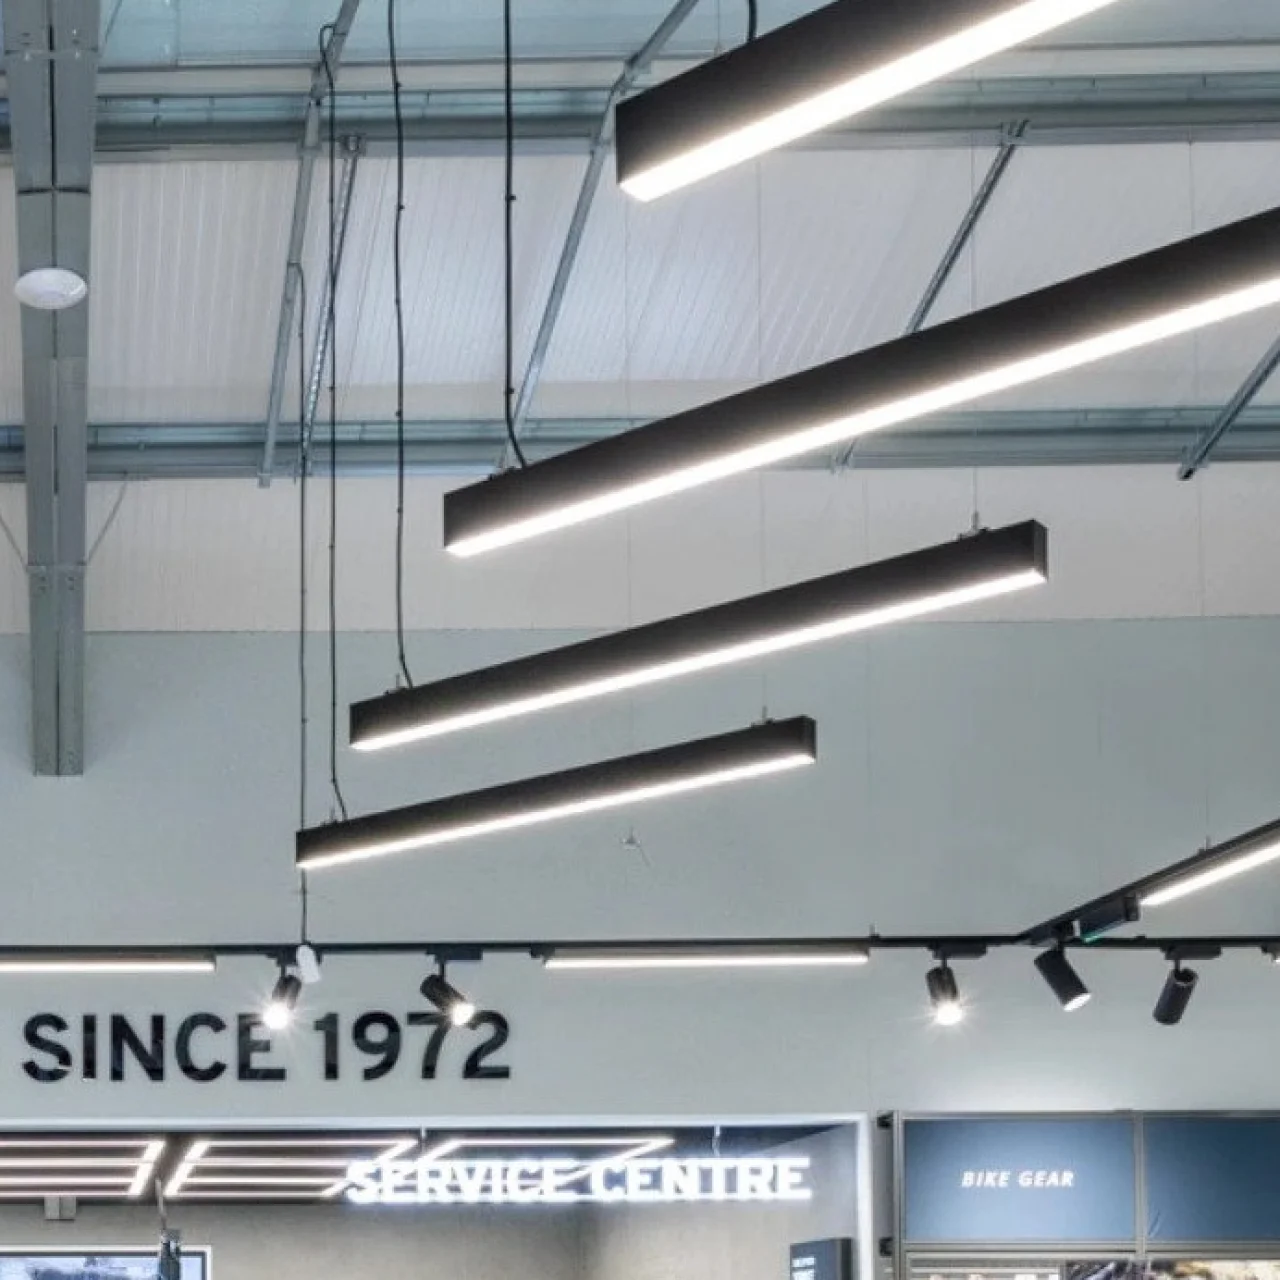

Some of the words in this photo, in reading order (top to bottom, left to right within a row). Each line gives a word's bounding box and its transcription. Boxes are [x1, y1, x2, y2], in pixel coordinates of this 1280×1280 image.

[22, 1012, 287, 1084] SINCE
[315, 1012, 512, 1083] 1972
[344, 1157, 581, 1204] SERVICE
[588, 1156, 812, 1202] CENTRE
[960, 1170, 1011, 1188] BIKE
[1018, 1170, 1075, 1188] GEAR
